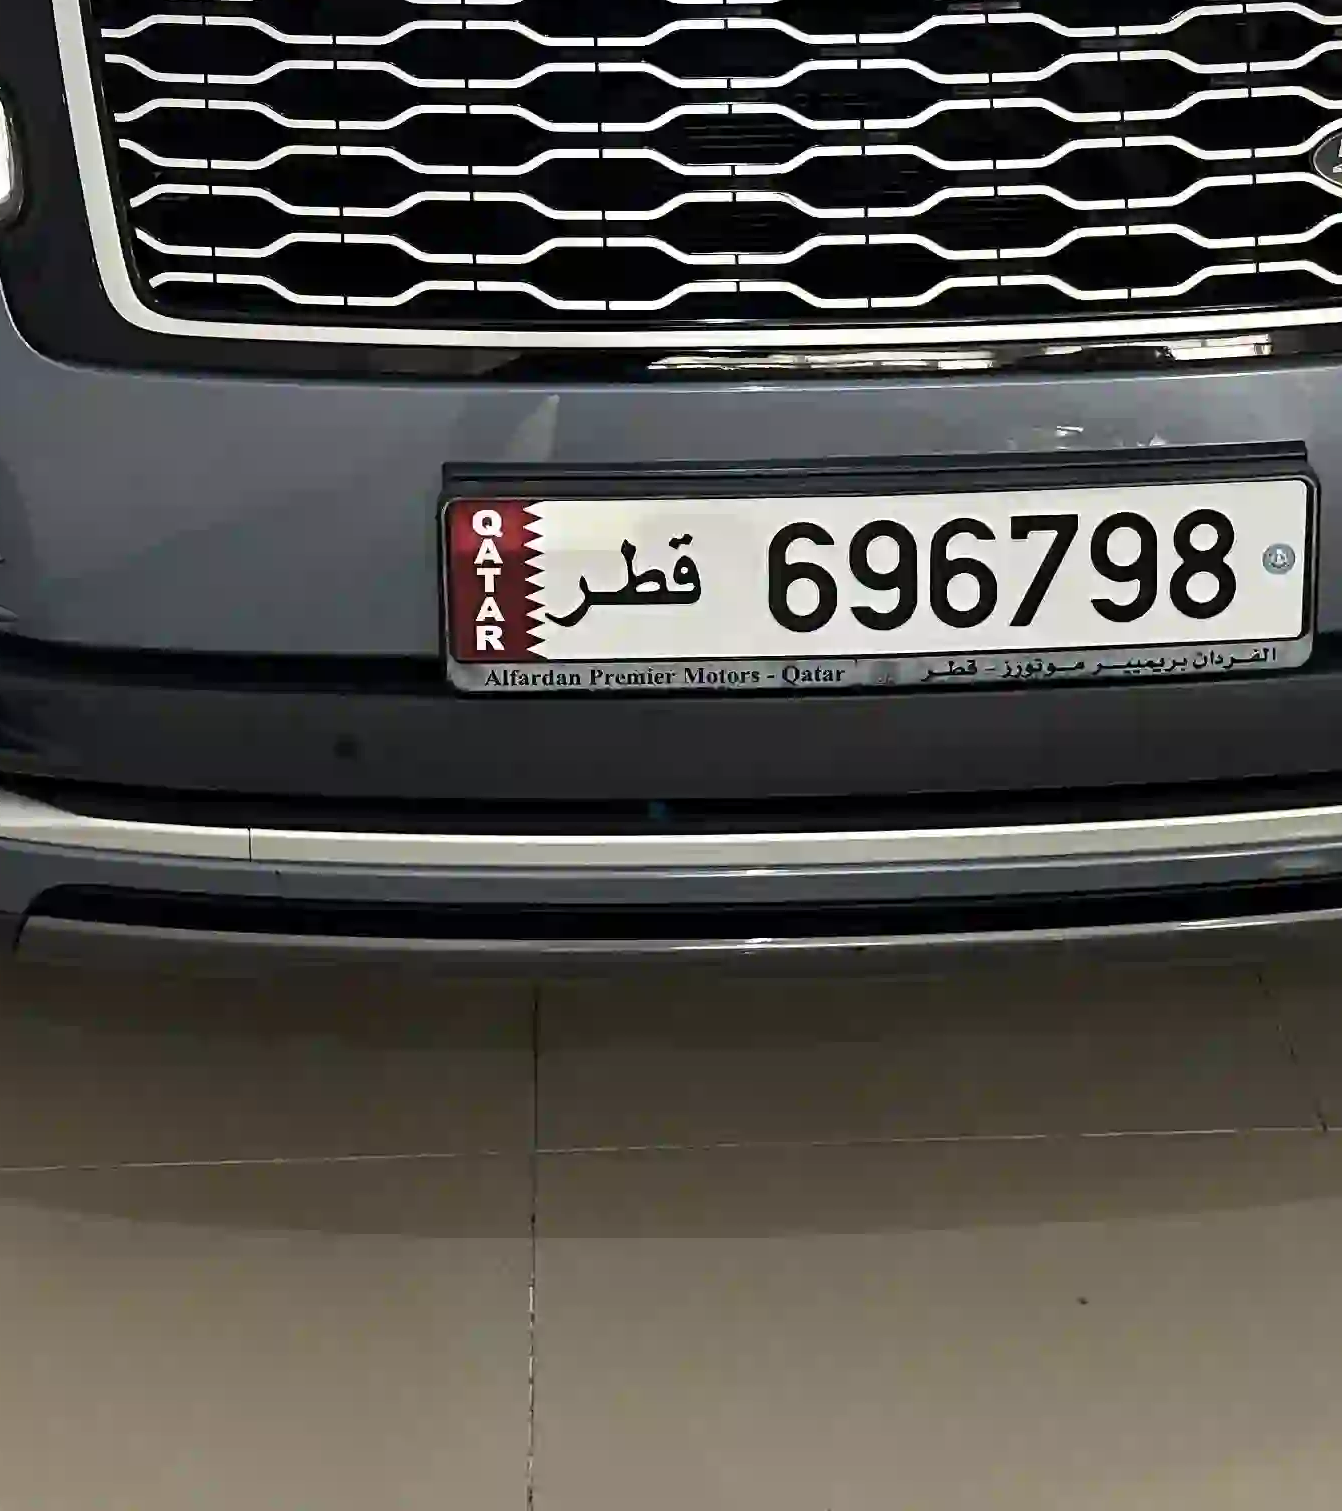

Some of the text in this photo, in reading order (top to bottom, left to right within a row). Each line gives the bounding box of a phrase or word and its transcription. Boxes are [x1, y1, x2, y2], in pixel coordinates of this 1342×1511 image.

[471, 509, 506, 651] QATAR
[545, 533, 702, 628] قطر
[767, 508, 1237, 633] 696798
[484, 668, 582, 687] Alfardan
[589, 666, 677, 687] Premier
[684, 666, 761, 685] Motors
[781, 664, 846, 686] Qatar
[920, 659, 978, 682] قطر
